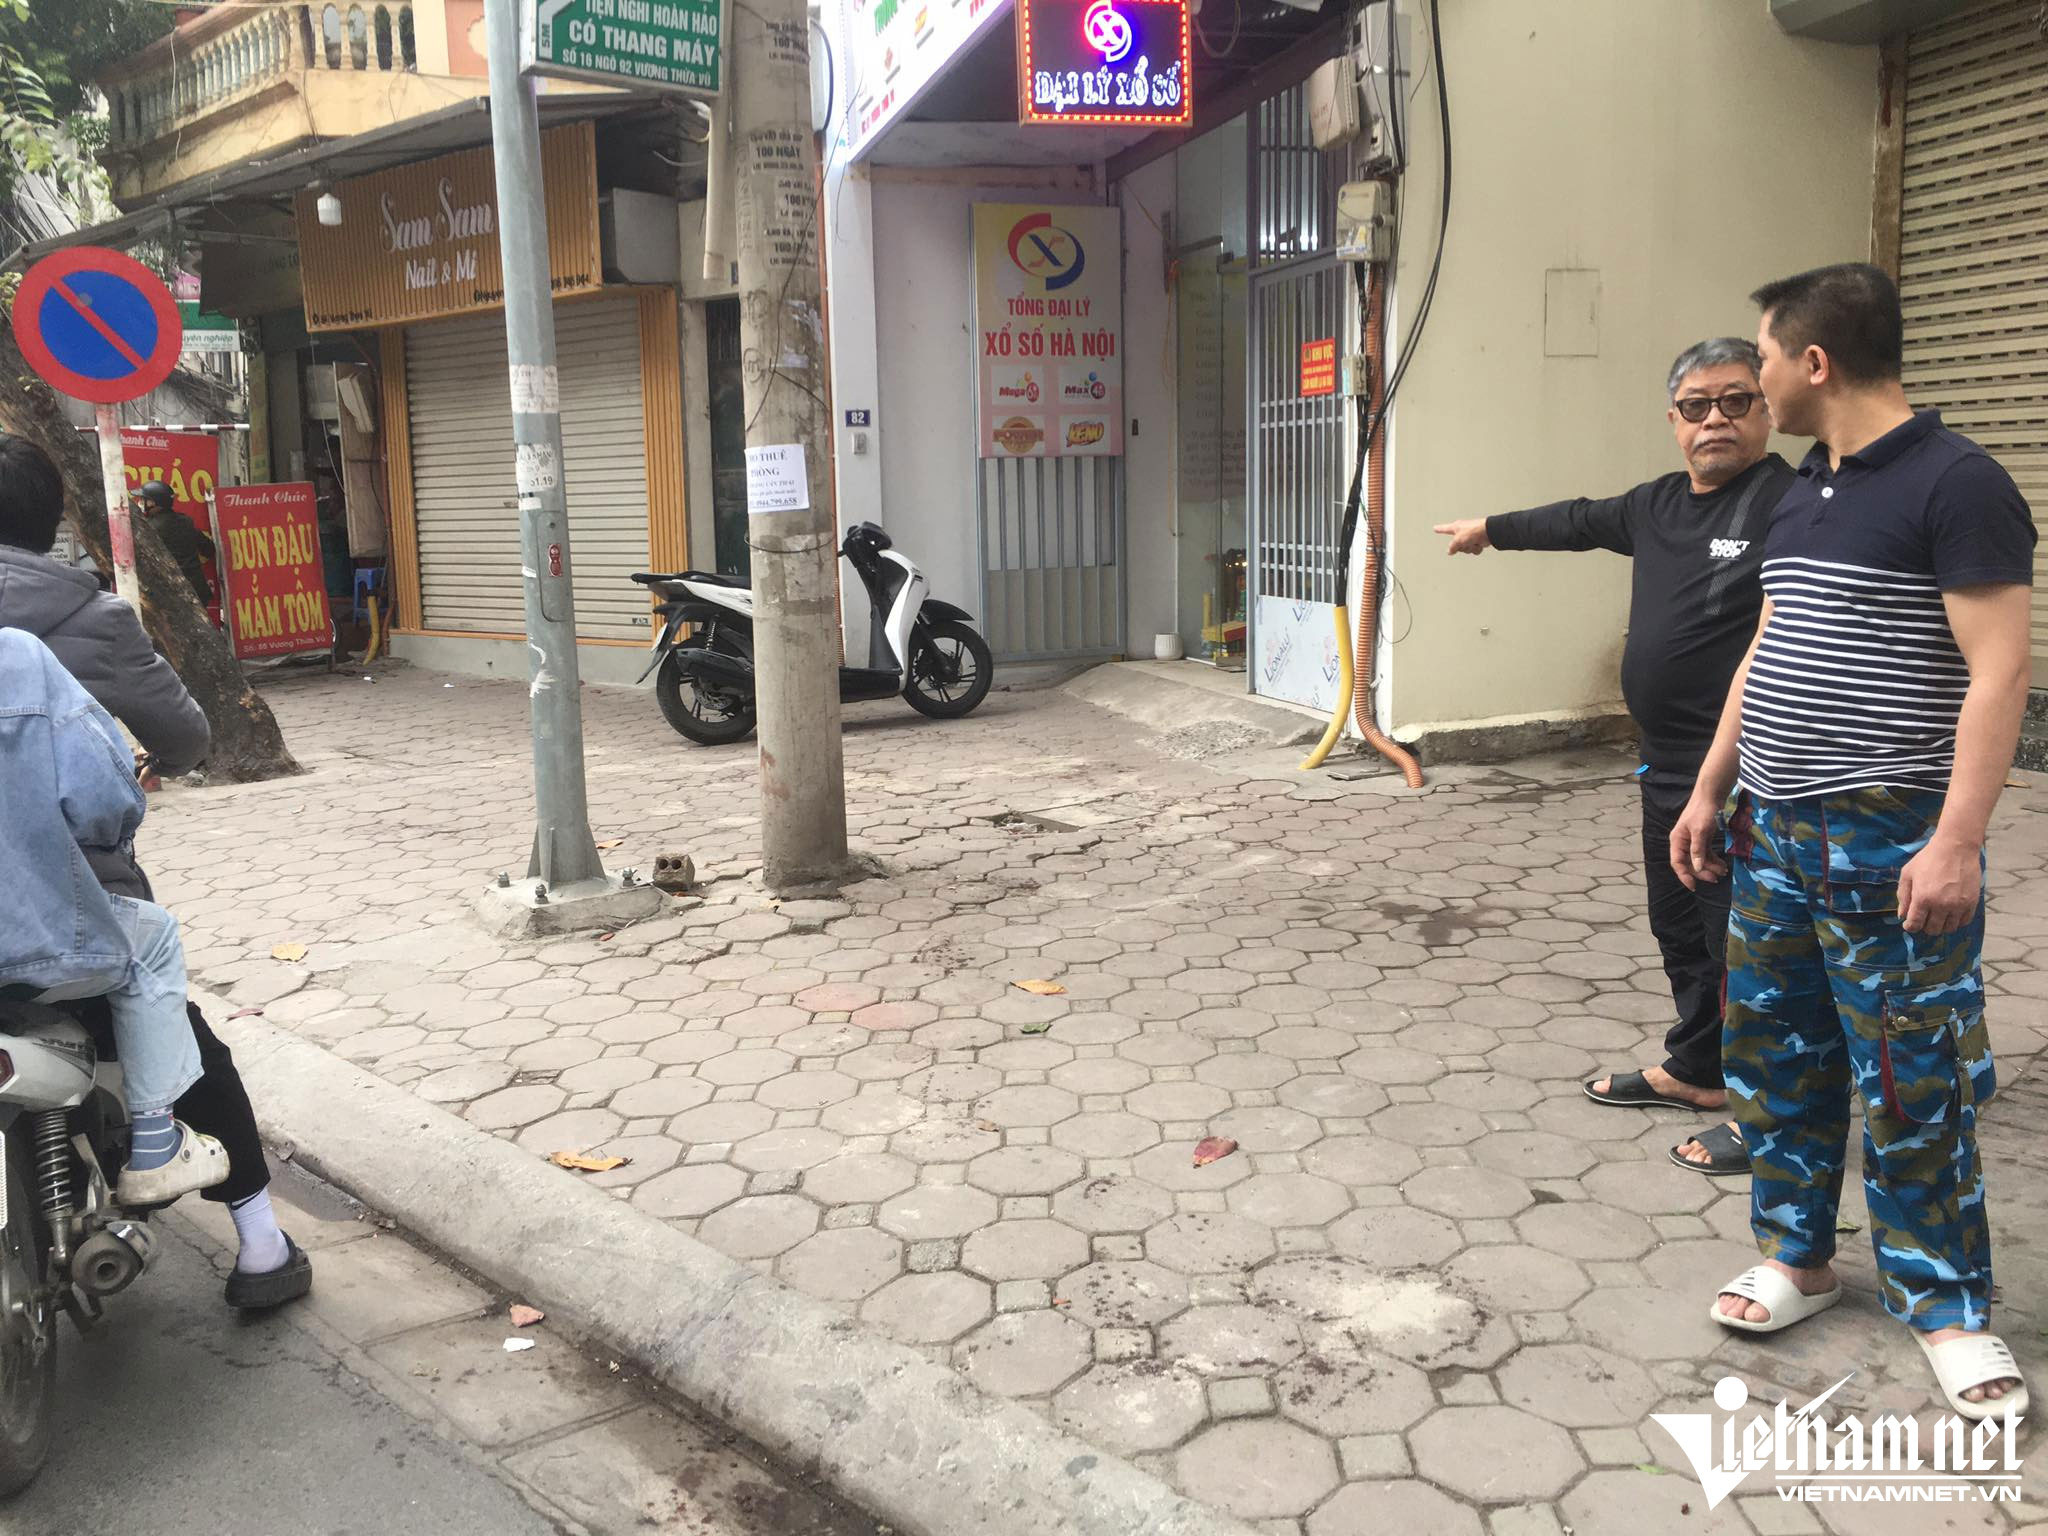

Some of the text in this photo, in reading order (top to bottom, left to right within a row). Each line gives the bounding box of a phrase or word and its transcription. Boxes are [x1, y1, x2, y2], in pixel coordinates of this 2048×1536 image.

[617, 0, 649, 23] NGHI
[653, 2, 688, 31] HOÀN
[691, 7, 717, 37] HẢO
[569, 18, 715, 68] CÓ THANG MÁY
[562, 46, 577, 64] SỐ
[580, 52, 593, 68] 16
[595, 54, 617, 72] NGÕ
[634, 62, 668, 81] VƯƠNG
[670, 67, 696, 84] THỪA
[405, 255, 437, 290] Nail
[441, 263, 452, 284] &
[1007, 291, 1091, 320] TỔNG ĐẠI LÝ
[985, 321, 1115, 362] XỔ SỐ HÀ NỘI
[851, 411, 865, 424] 82
[120, 433, 170, 447] hanh Chúc
[223, 490, 307, 508] Thanh Chúc
[228, 512, 314, 576] BÚN ĐẬU
[1709, 538, 1751, 552] DON'T
[1709, 547, 1742, 558] STOP
[236, 573, 326, 641] MẮM TÔM
